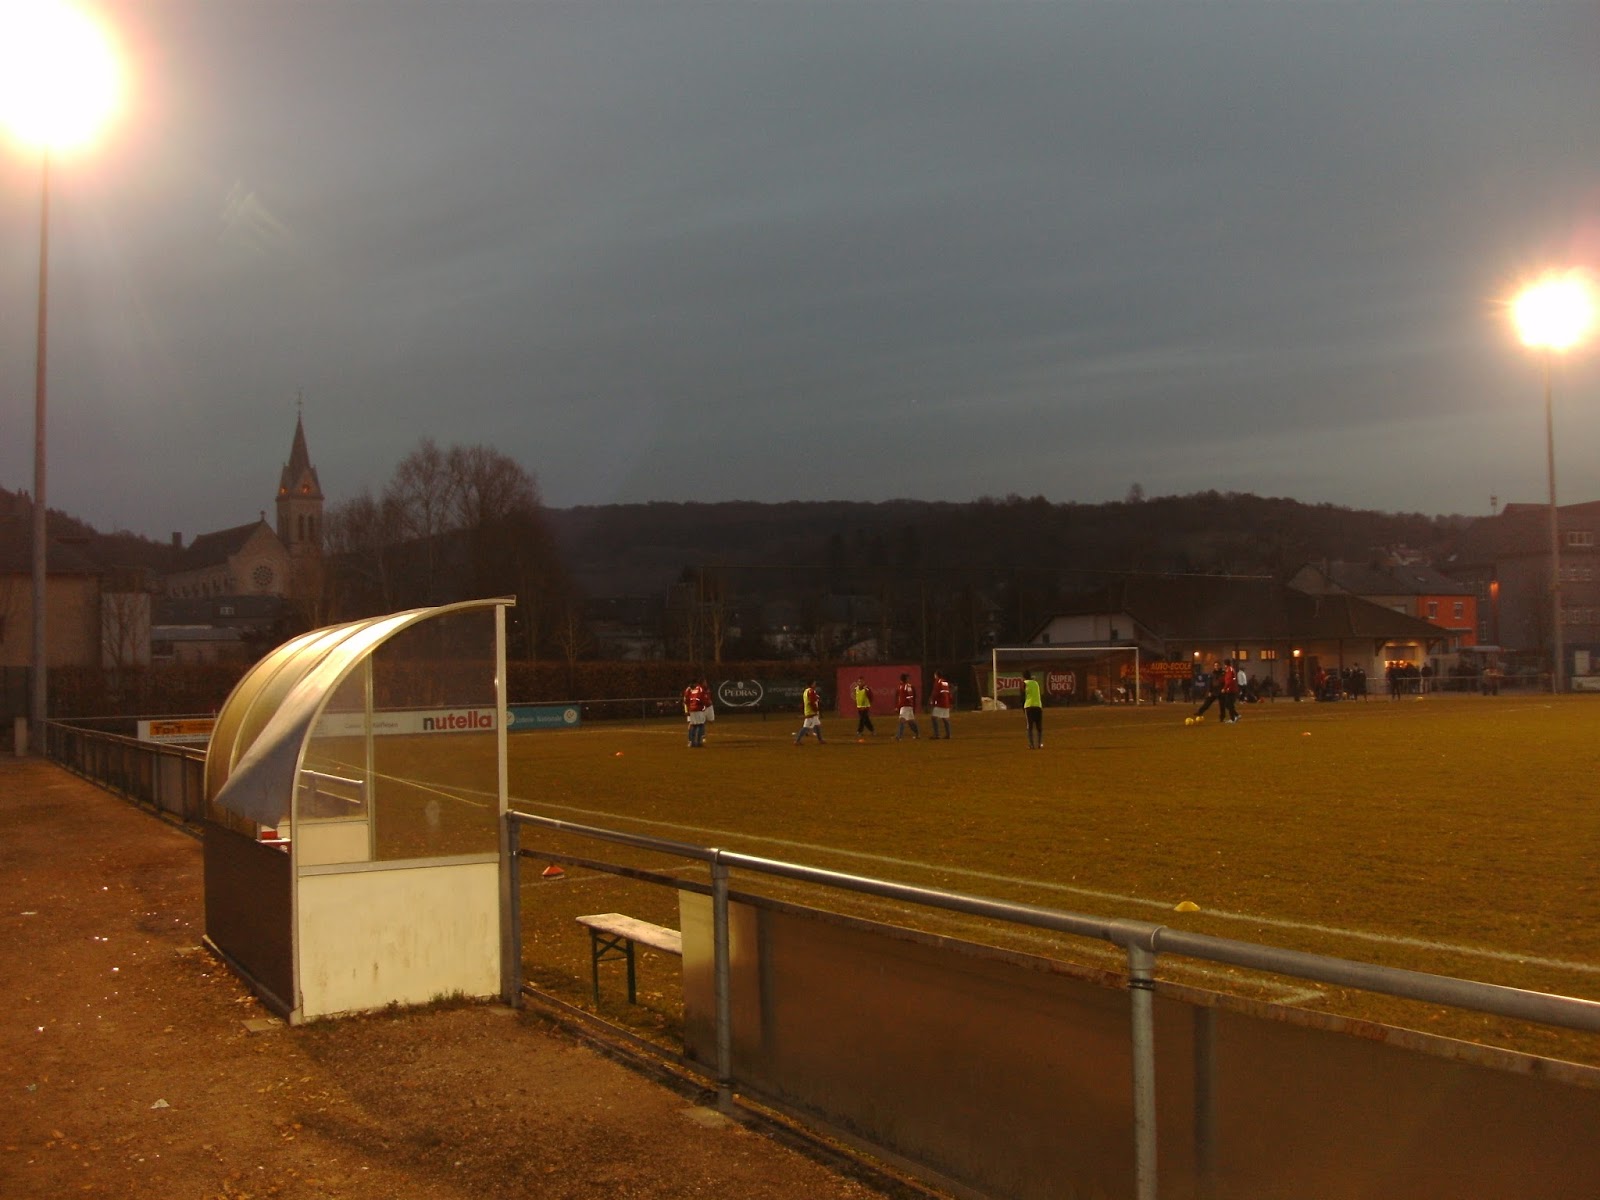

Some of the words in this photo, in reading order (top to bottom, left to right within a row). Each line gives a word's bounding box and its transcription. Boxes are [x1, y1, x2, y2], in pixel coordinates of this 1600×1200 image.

[1050, 674, 1073, 683] SUPER
[1051, 682, 1072, 691] BOCK
[724, 689, 758, 697] PEDRAS
[423, 710, 492, 731] nutella
